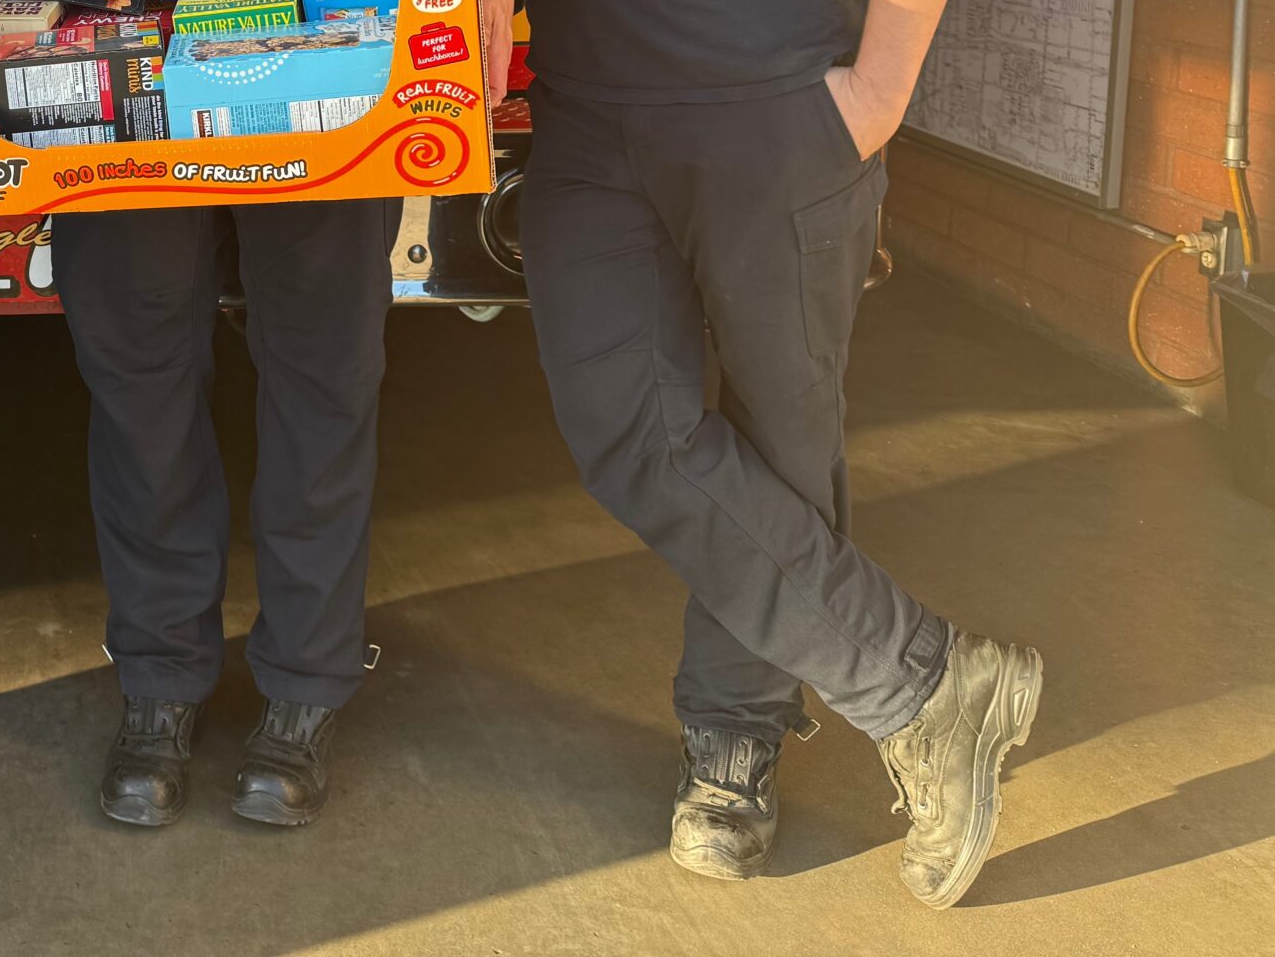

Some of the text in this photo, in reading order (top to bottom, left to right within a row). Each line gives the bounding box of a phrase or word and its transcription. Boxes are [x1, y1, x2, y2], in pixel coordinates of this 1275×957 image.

[180, 1, 229, 13] VALLEY
[74, 15, 160, 26] CHEWY
[178, 17, 235, 36] NATURE
[119, 22, 138, 38] KIND
[421, 34, 454, 47] PERFECT
[432, 44, 446, 53] FOR
[417, 49, 464, 65] lunchboxes!
[126, 58, 138, 94] minis
[139, 57, 154, 91] KIND
[410, 99, 463, 118] WHIPS
[53, 166, 94, 189] 100
[172, 163, 200, 180] OF
